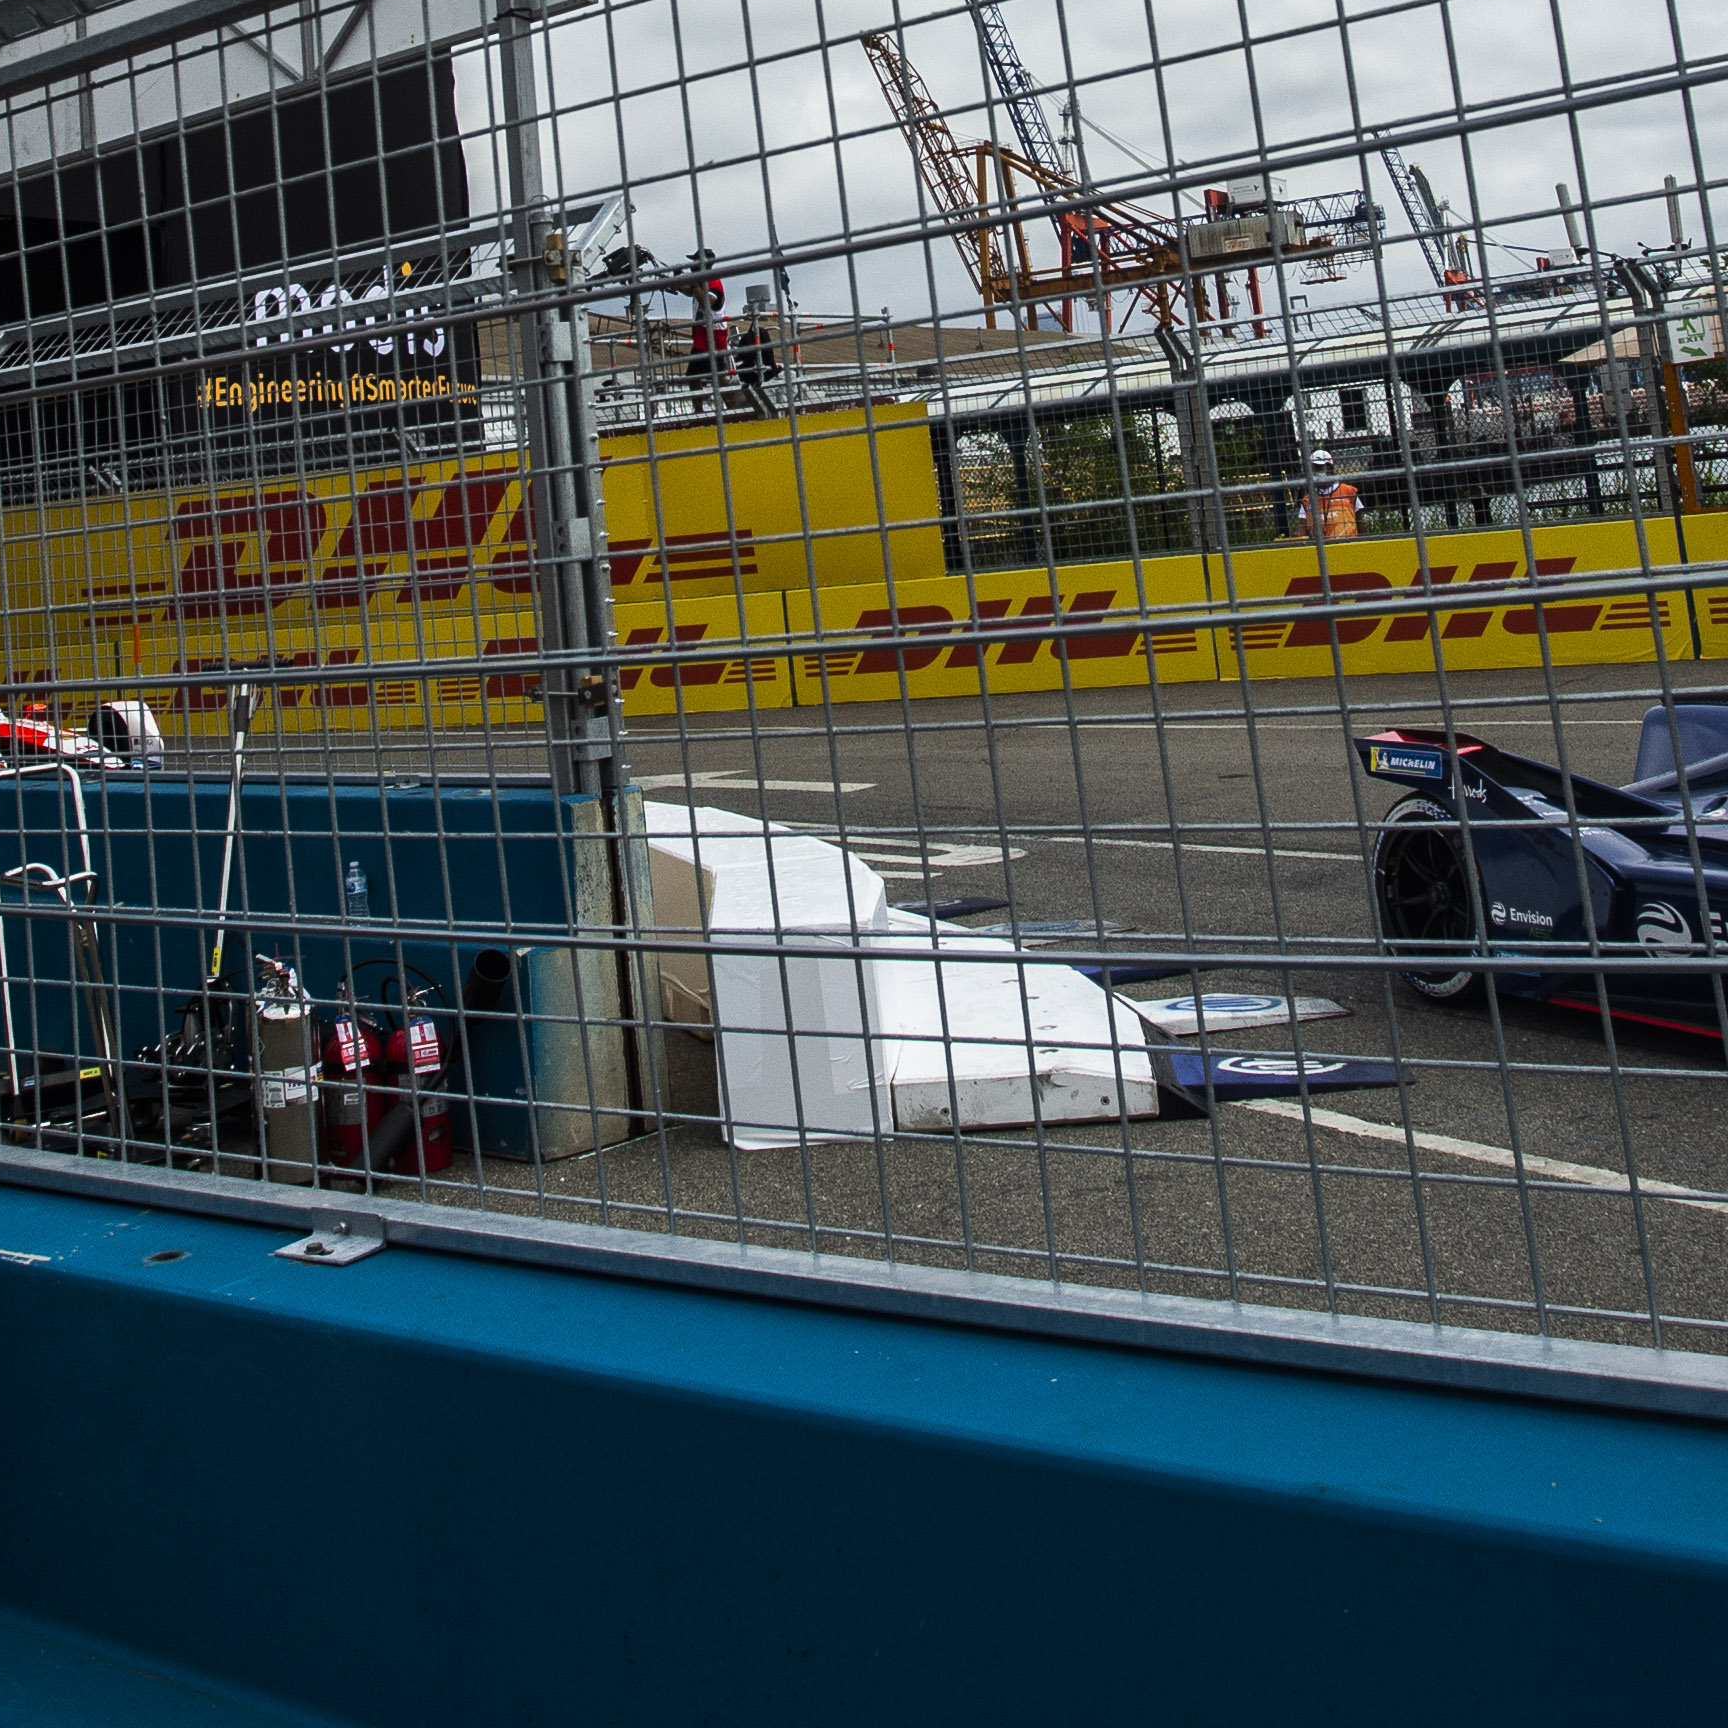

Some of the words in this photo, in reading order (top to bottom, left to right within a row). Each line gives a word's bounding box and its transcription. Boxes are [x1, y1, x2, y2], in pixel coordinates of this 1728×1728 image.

[1677, 333, 1706, 345] EXIT
[1283, 556, 1604, 648] DHL
[853, 589, 1140, 675] DHL
[1389, 756, 1437, 771] MICHELIN
[1510, 907, 1554, 927] Envision
